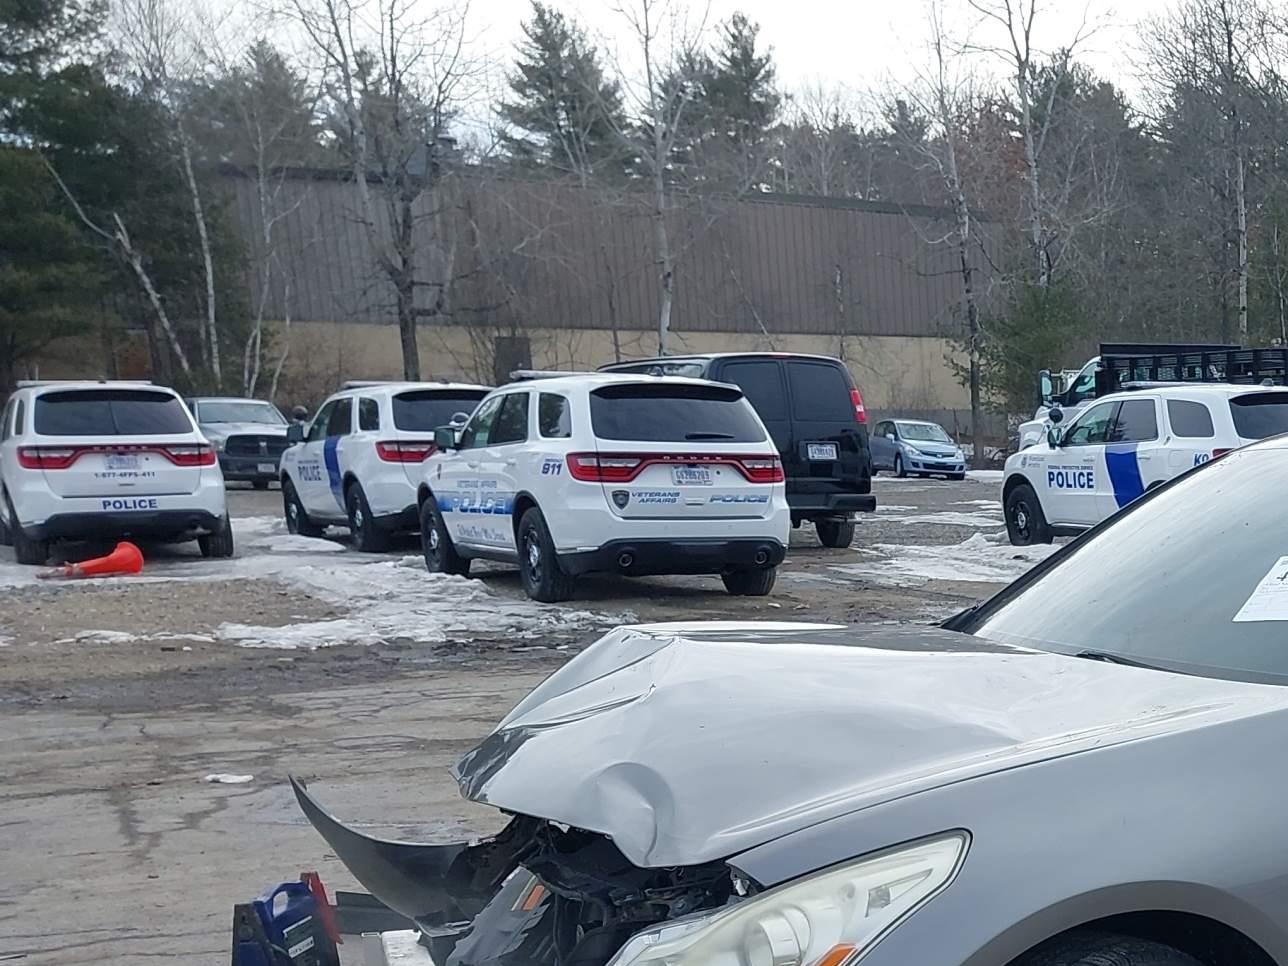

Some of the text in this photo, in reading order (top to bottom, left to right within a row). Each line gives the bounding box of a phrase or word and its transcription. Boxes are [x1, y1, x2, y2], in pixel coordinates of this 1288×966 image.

[1047, 471, 1095, 488] POLICE
[102, 498, 158, 510] POLICE
[709, 494, 769, 503] POLICE
